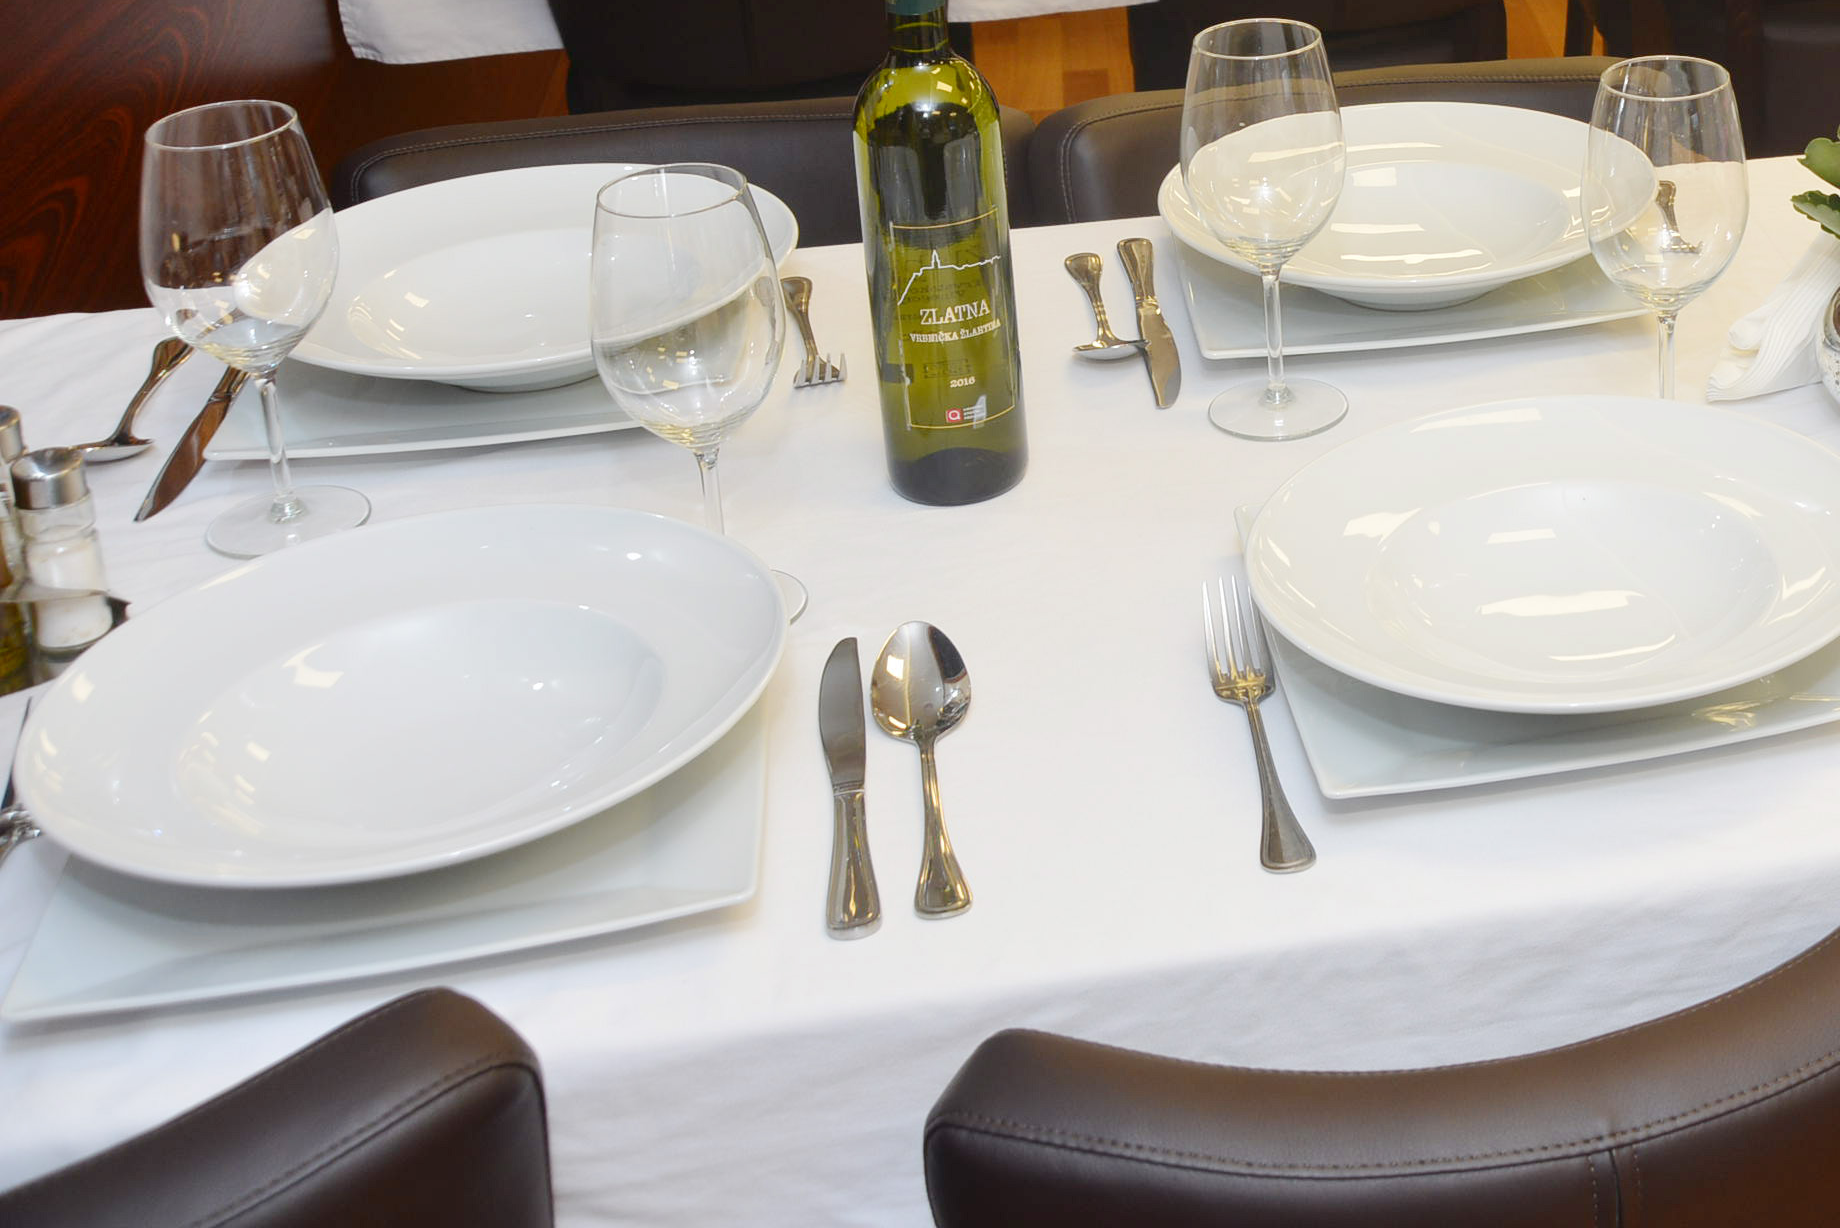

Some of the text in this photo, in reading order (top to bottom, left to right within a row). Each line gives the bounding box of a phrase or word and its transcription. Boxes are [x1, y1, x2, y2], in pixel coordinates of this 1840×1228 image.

[920, 299, 990, 325] ZLATNA
[910, 331, 959, 343] VRBNIČKA
[950, 376, 976, 388] 2016
